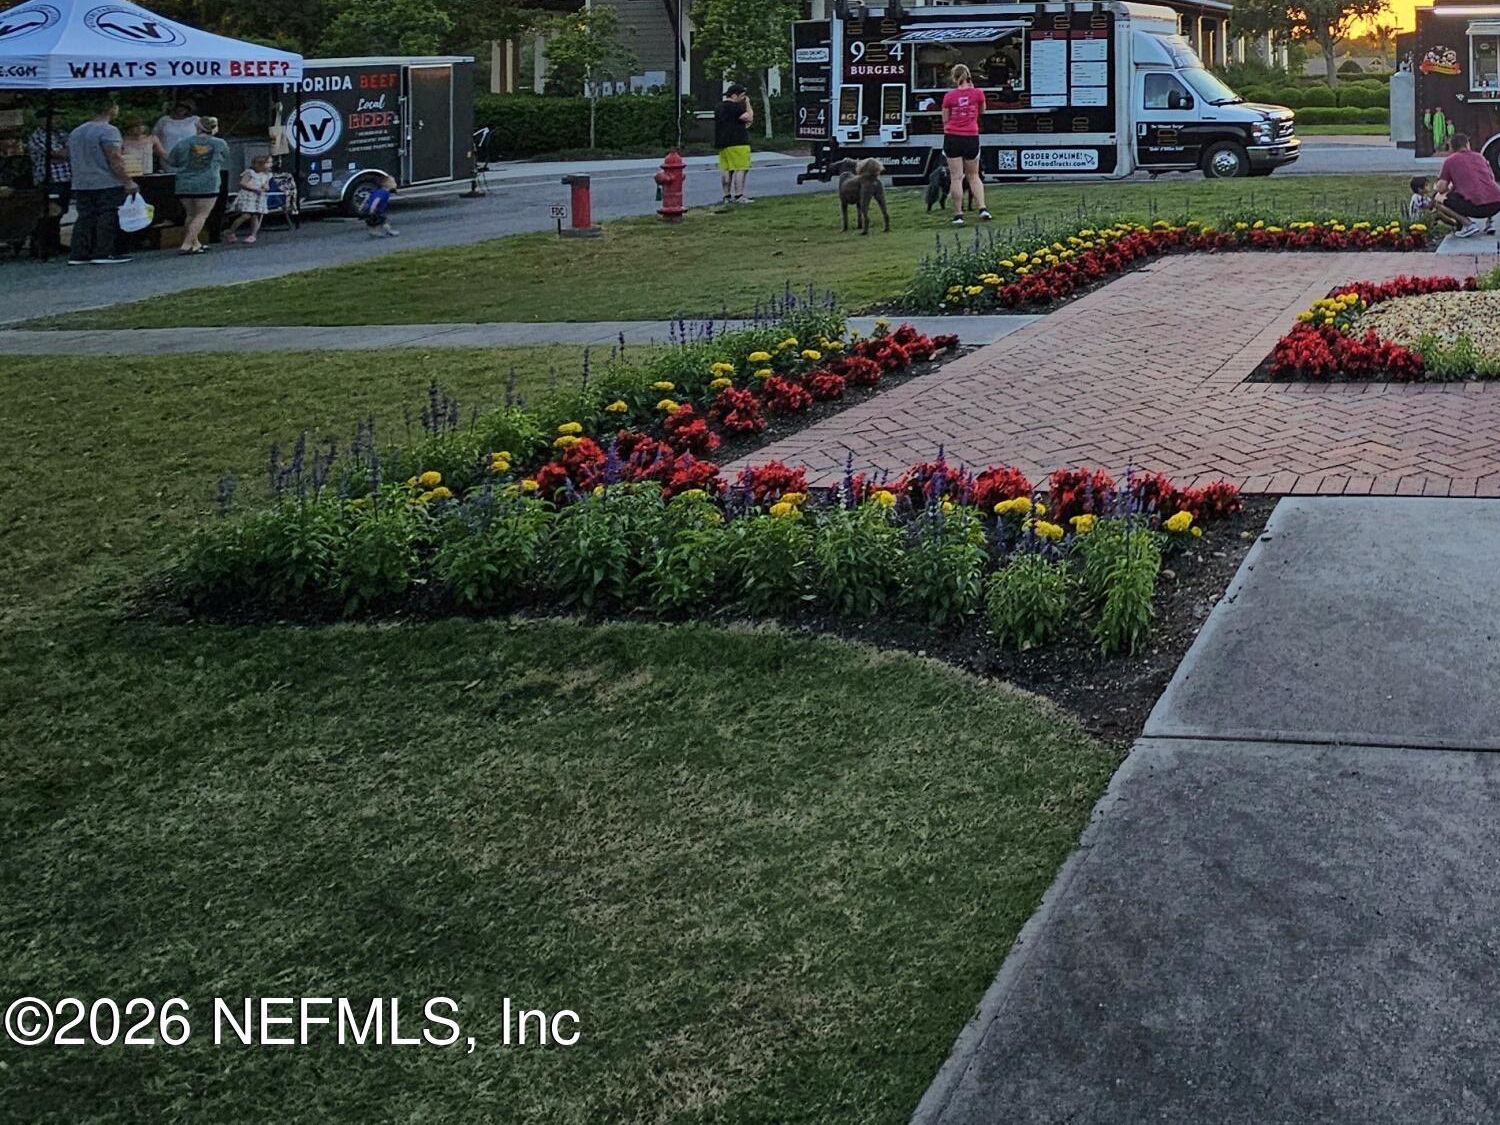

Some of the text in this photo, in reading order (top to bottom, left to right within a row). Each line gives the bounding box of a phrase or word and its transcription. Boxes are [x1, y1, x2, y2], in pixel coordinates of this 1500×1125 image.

[68, 60, 290, 78] WHAT'S YOUR BEEF?
[850, 65, 905, 75] BURGERS
[360, 74, 397, 88] BEEF
[357, 93, 385, 111] Local
[1051, 152, 1083, 160] ONLINE!
[551, 207, 565, 216] FDC
